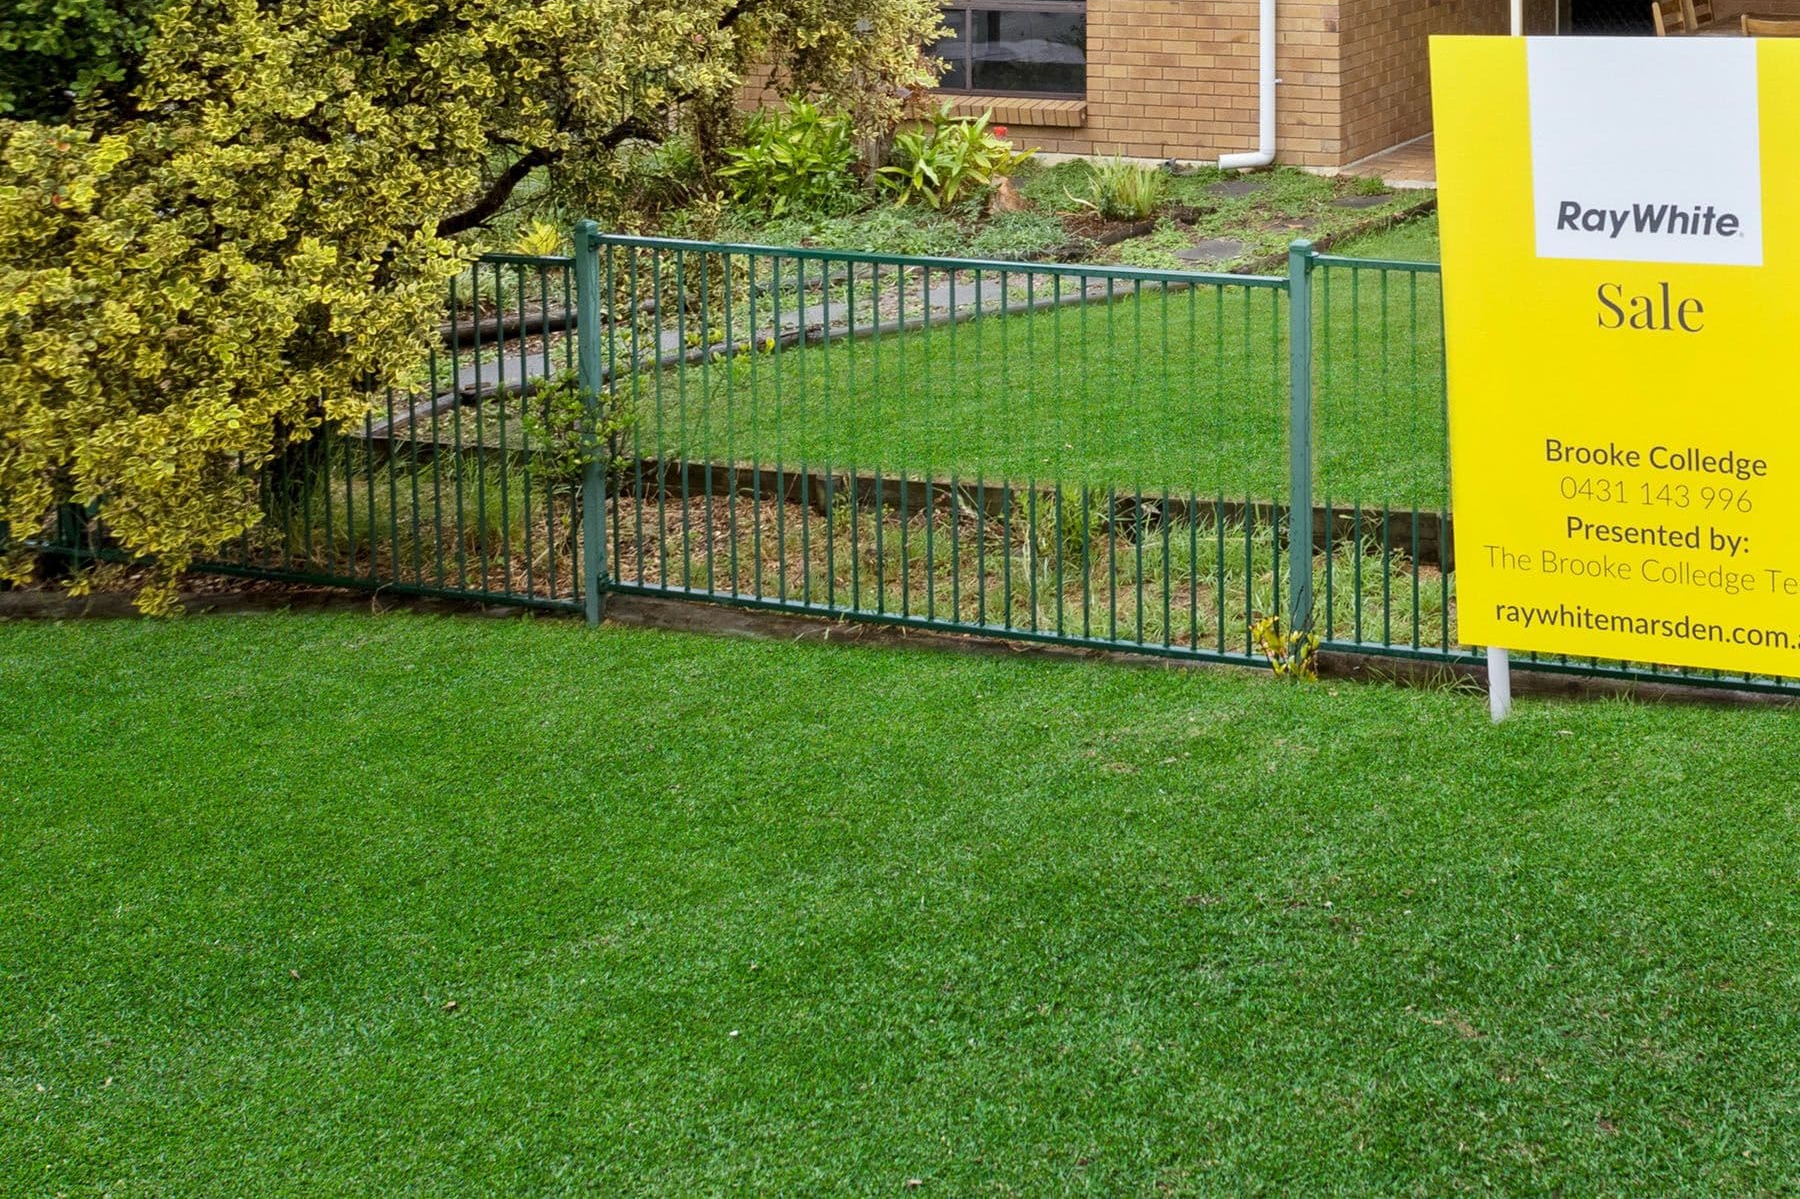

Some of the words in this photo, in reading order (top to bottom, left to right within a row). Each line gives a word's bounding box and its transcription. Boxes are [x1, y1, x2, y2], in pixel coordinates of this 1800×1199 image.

[1597, 281, 1704, 333] Sale
[1545, 438, 1641, 468] Brooke
[1649, 445, 1768, 481] Colledge
[1560, 476, 1629, 504] 0431
[1640, 482, 1690, 509] 143
[1700, 486, 1753, 514] 996
[1566, 515, 1700, 550] Presented
[1710, 526, 1749, 557] by:
[1483, 544, 1532, 572] The
[1541, 549, 1632, 581] Brooke
[1641, 558, 1756, 596] Colledge
